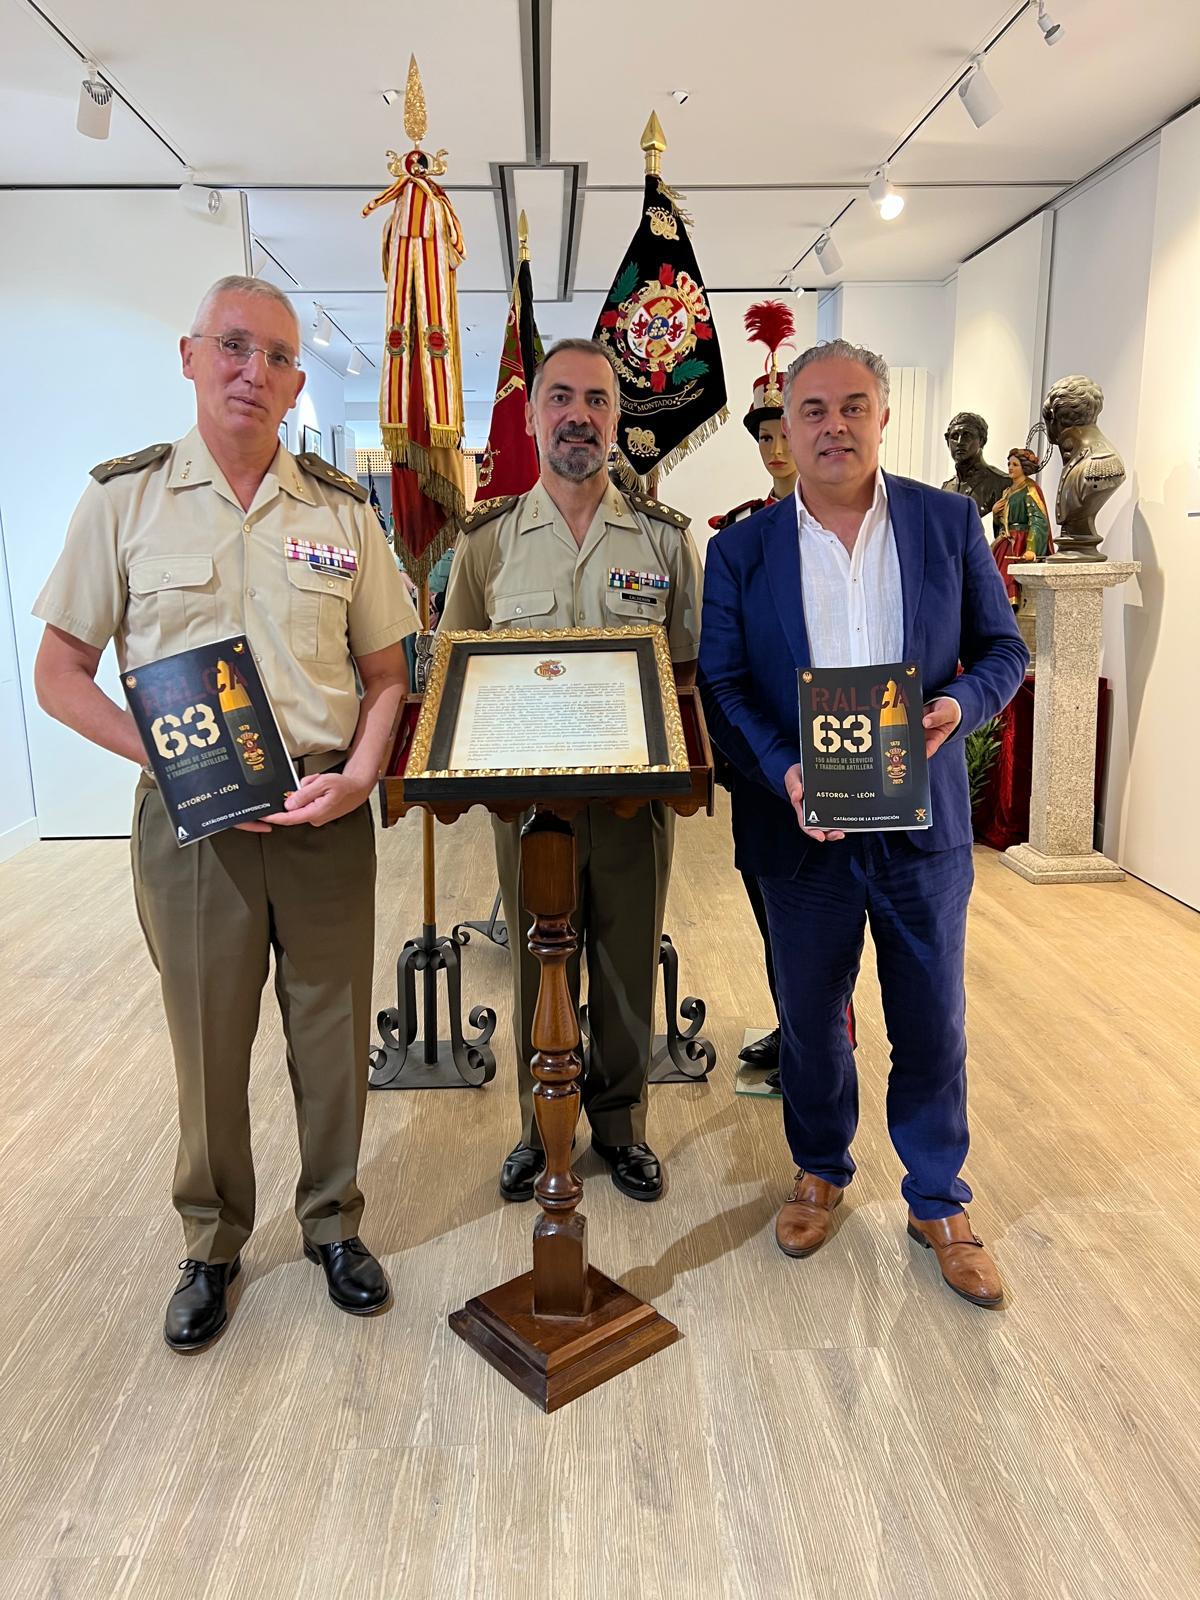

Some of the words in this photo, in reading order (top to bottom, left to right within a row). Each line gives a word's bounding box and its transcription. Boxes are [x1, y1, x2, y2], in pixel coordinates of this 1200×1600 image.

[637, 399, 673, 412] MONTADO
[810, 682, 910, 712] RALCA
[150, 703, 221, 760] 63
[812, 714, 873, 753] 63
[200, 747, 227, 760] SERVICIO
[826, 756, 840, 764] AÑOS
[849, 756, 874, 764] SERVICIO
[200, 754, 229, 768] ARTILLERA
[819, 763, 846, 771] TRADICIÓN
[846, 763, 874, 771] ARTILLERA
[177, 793, 212, 810] ASTORGA
[219, 783, 239, 795] LEÓN
[816, 791, 849, 799] ASTORGA
[856, 791, 875, 799] LEÓN
